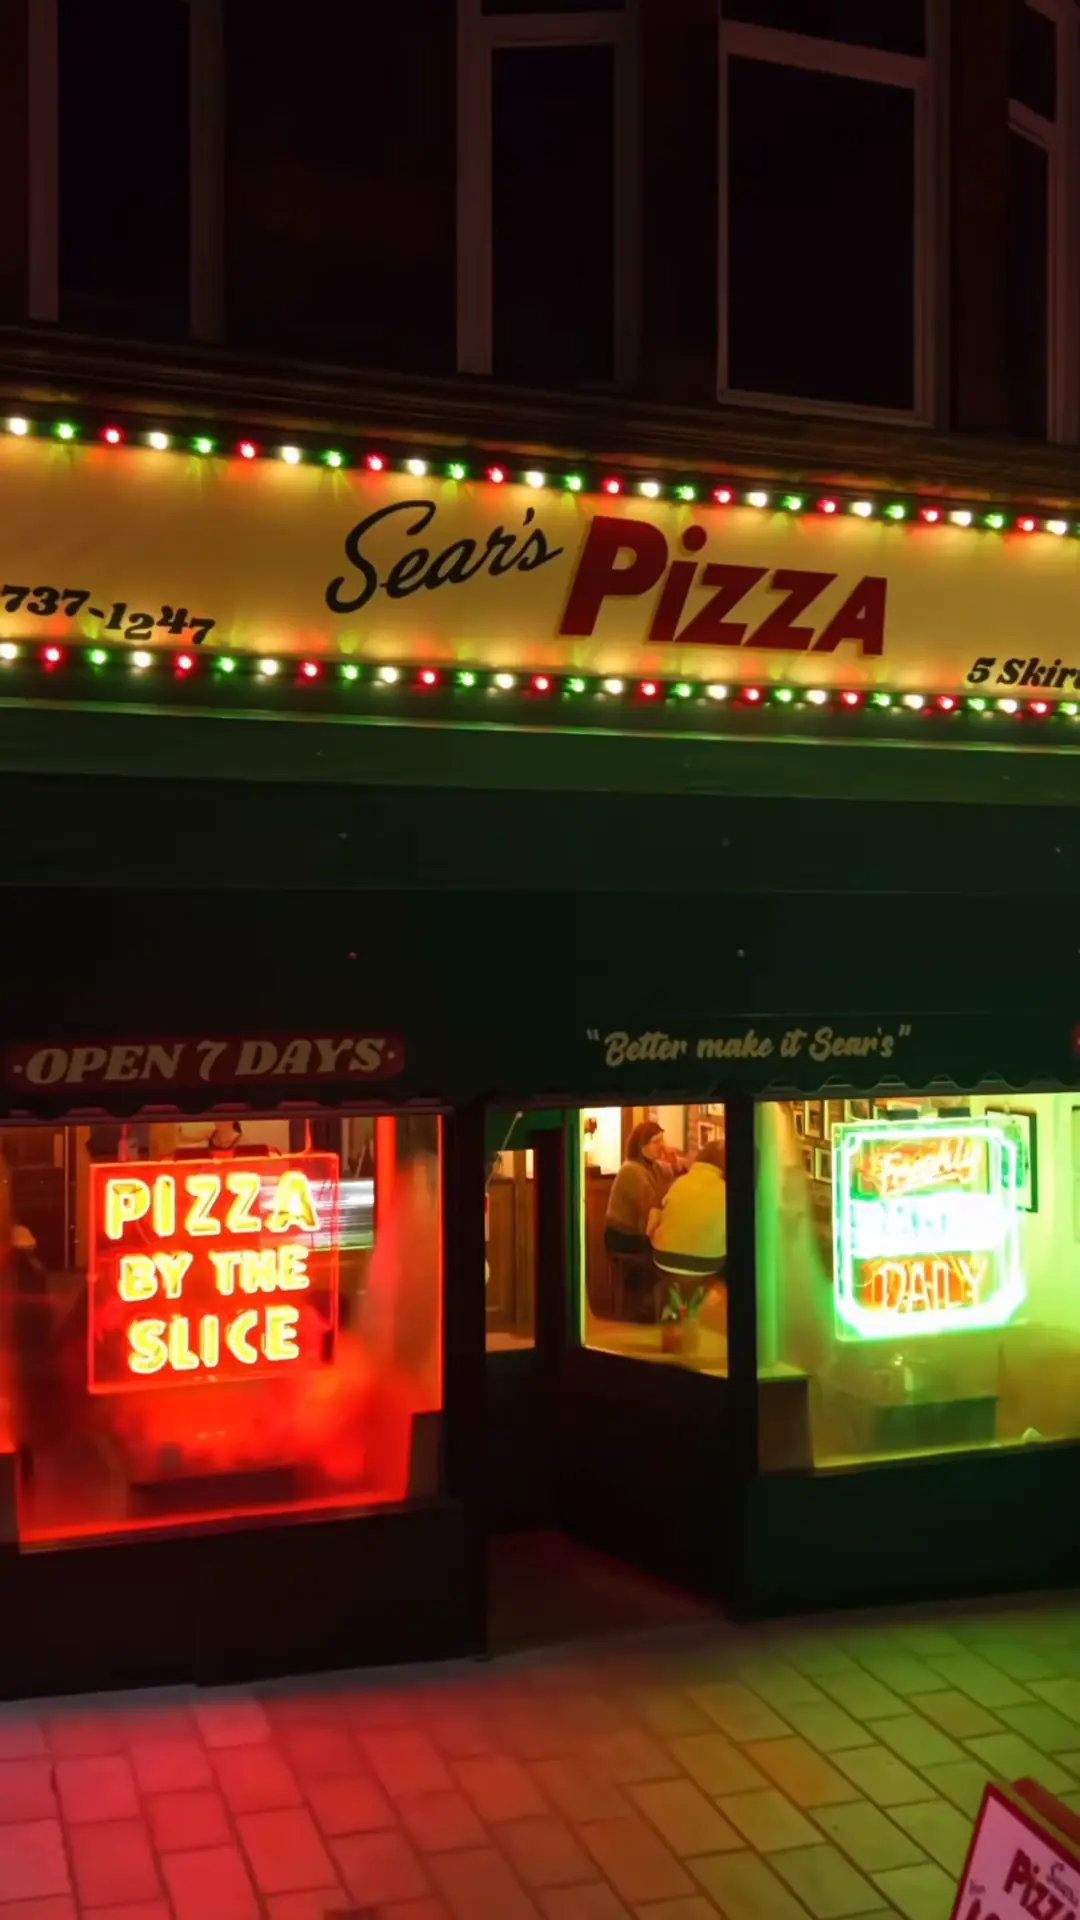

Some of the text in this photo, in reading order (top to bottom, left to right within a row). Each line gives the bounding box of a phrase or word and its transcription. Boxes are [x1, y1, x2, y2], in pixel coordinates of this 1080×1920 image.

[325, 500, 563, 613] Sear's
[1, 584, 215, 644] 737-1247
[967, 657, 997, 684] 5
[26, 1038, 385, 1084] OPEN 7 DAYS
[697, 1029, 773, 1059] make
[780, 1027, 809, 1058] it
[104, 1171, 321, 1240] PIZZA
[118, 1245, 310, 1302] BY THE
[874, 1257, 987, 1313] DAILY
[128, 1305, 300, 1374] SLICE
